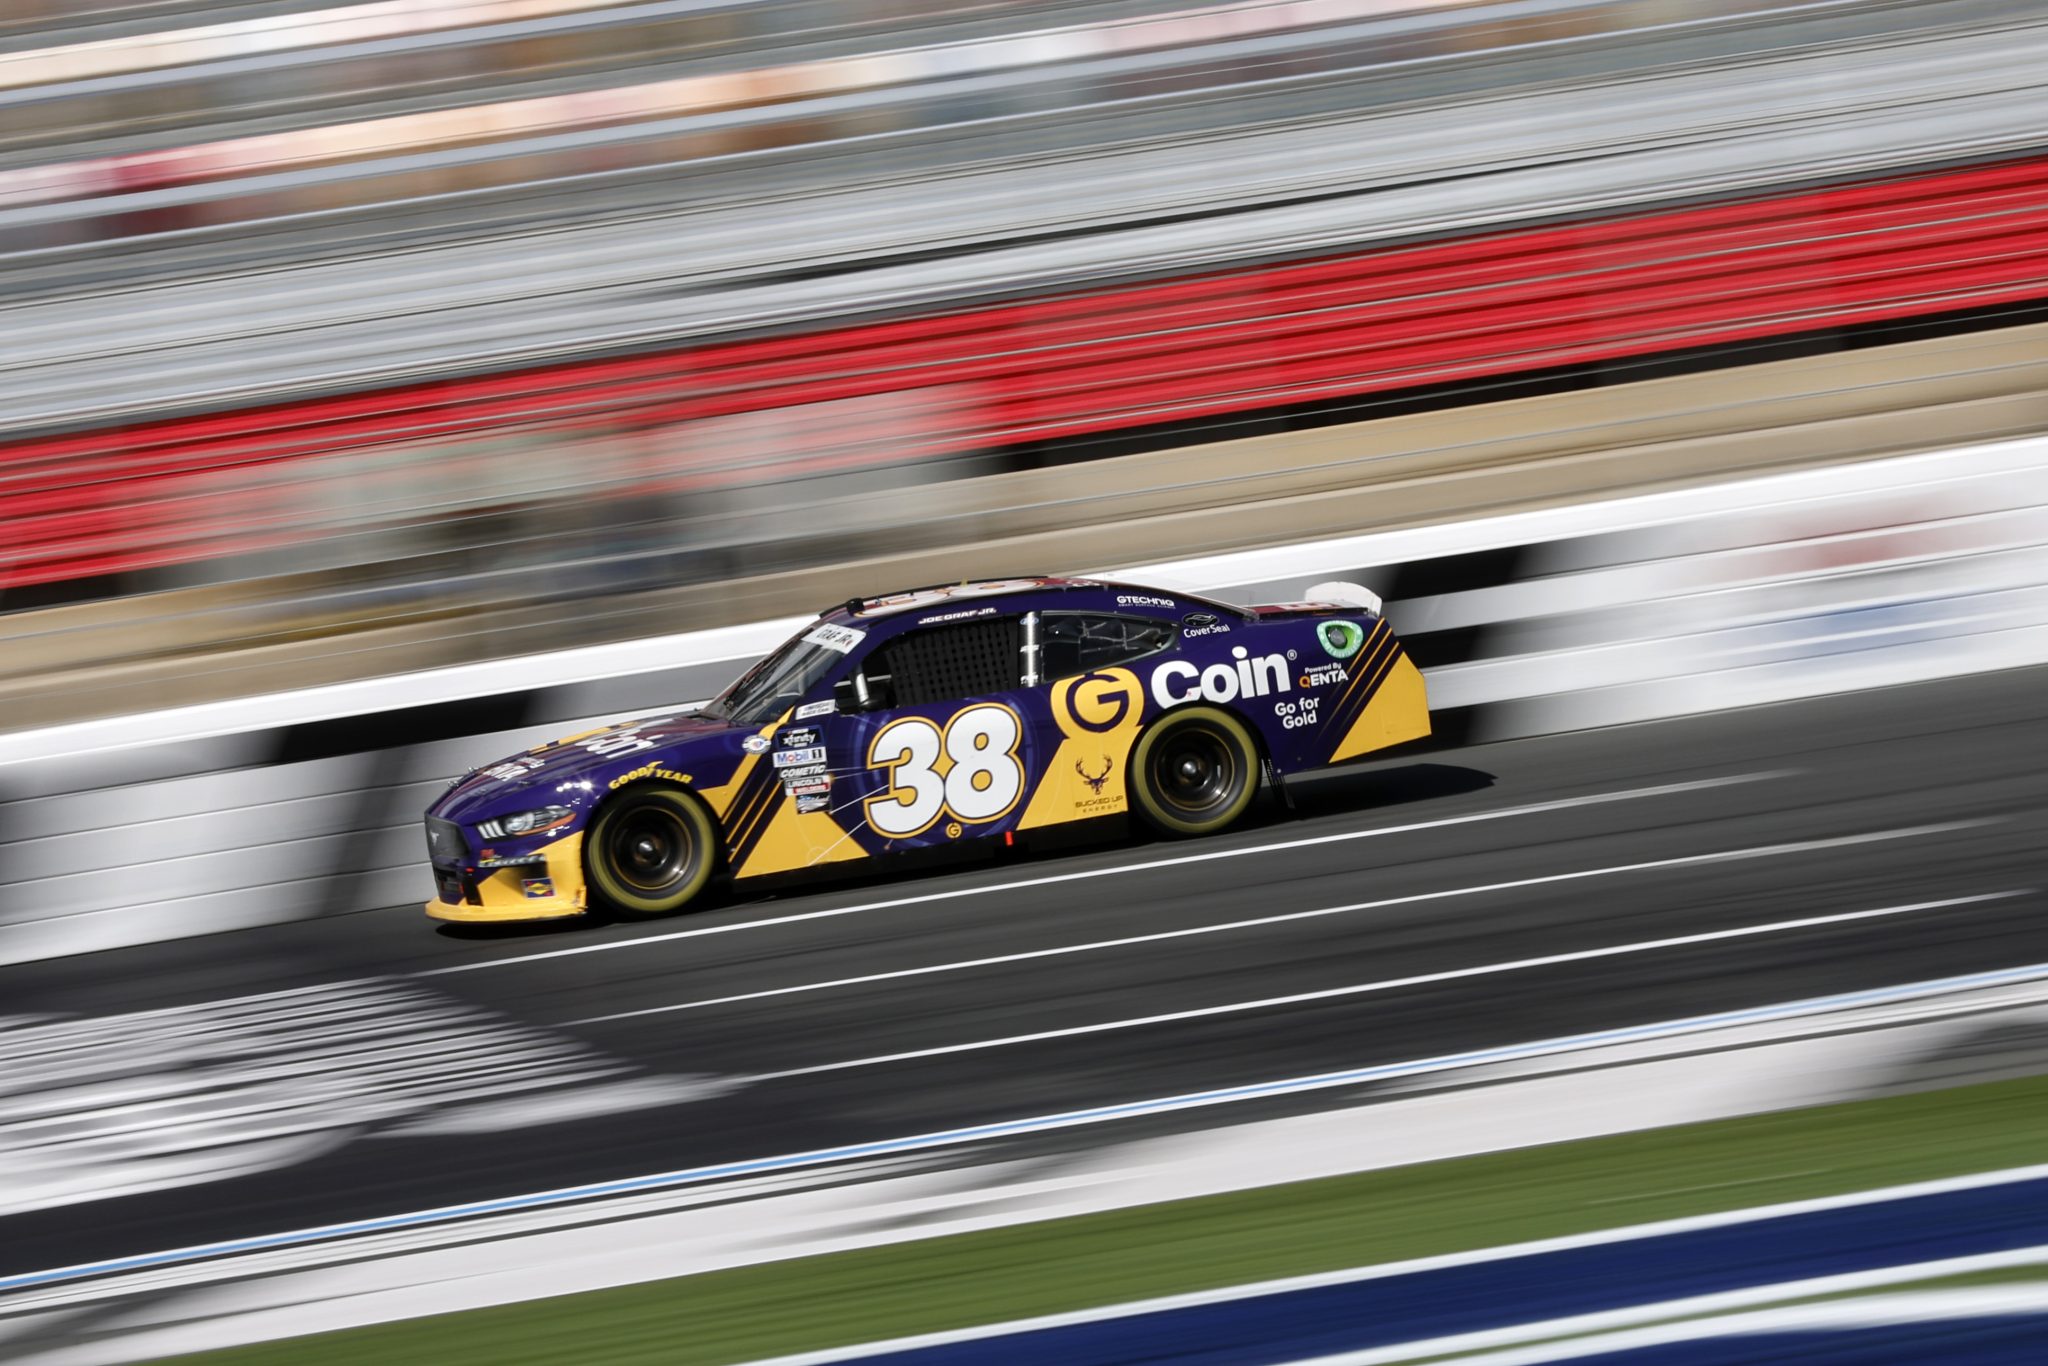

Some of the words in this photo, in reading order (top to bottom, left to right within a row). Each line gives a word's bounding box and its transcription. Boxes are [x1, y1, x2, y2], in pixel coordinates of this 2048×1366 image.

[918, 616, 943, 624] JOE
[944, 610, 977, 620] GRAF
[1183, 624, 1230, 638] CoverSeal
[1151, 646, 1291, 709] Coin
[1304, 664, 1332, 674] Powered
[1333, 662, 1342, 670] By
[1299, 669, 1349, 688] QENTA
[1274, 702, 1296, 716] Go
[1299, 697, 1320, 711] for
[1282, 710, 1317, 729] Gold
[777, 750, 809, 763] Mobil
[863, 702, 1025, 838] 38
